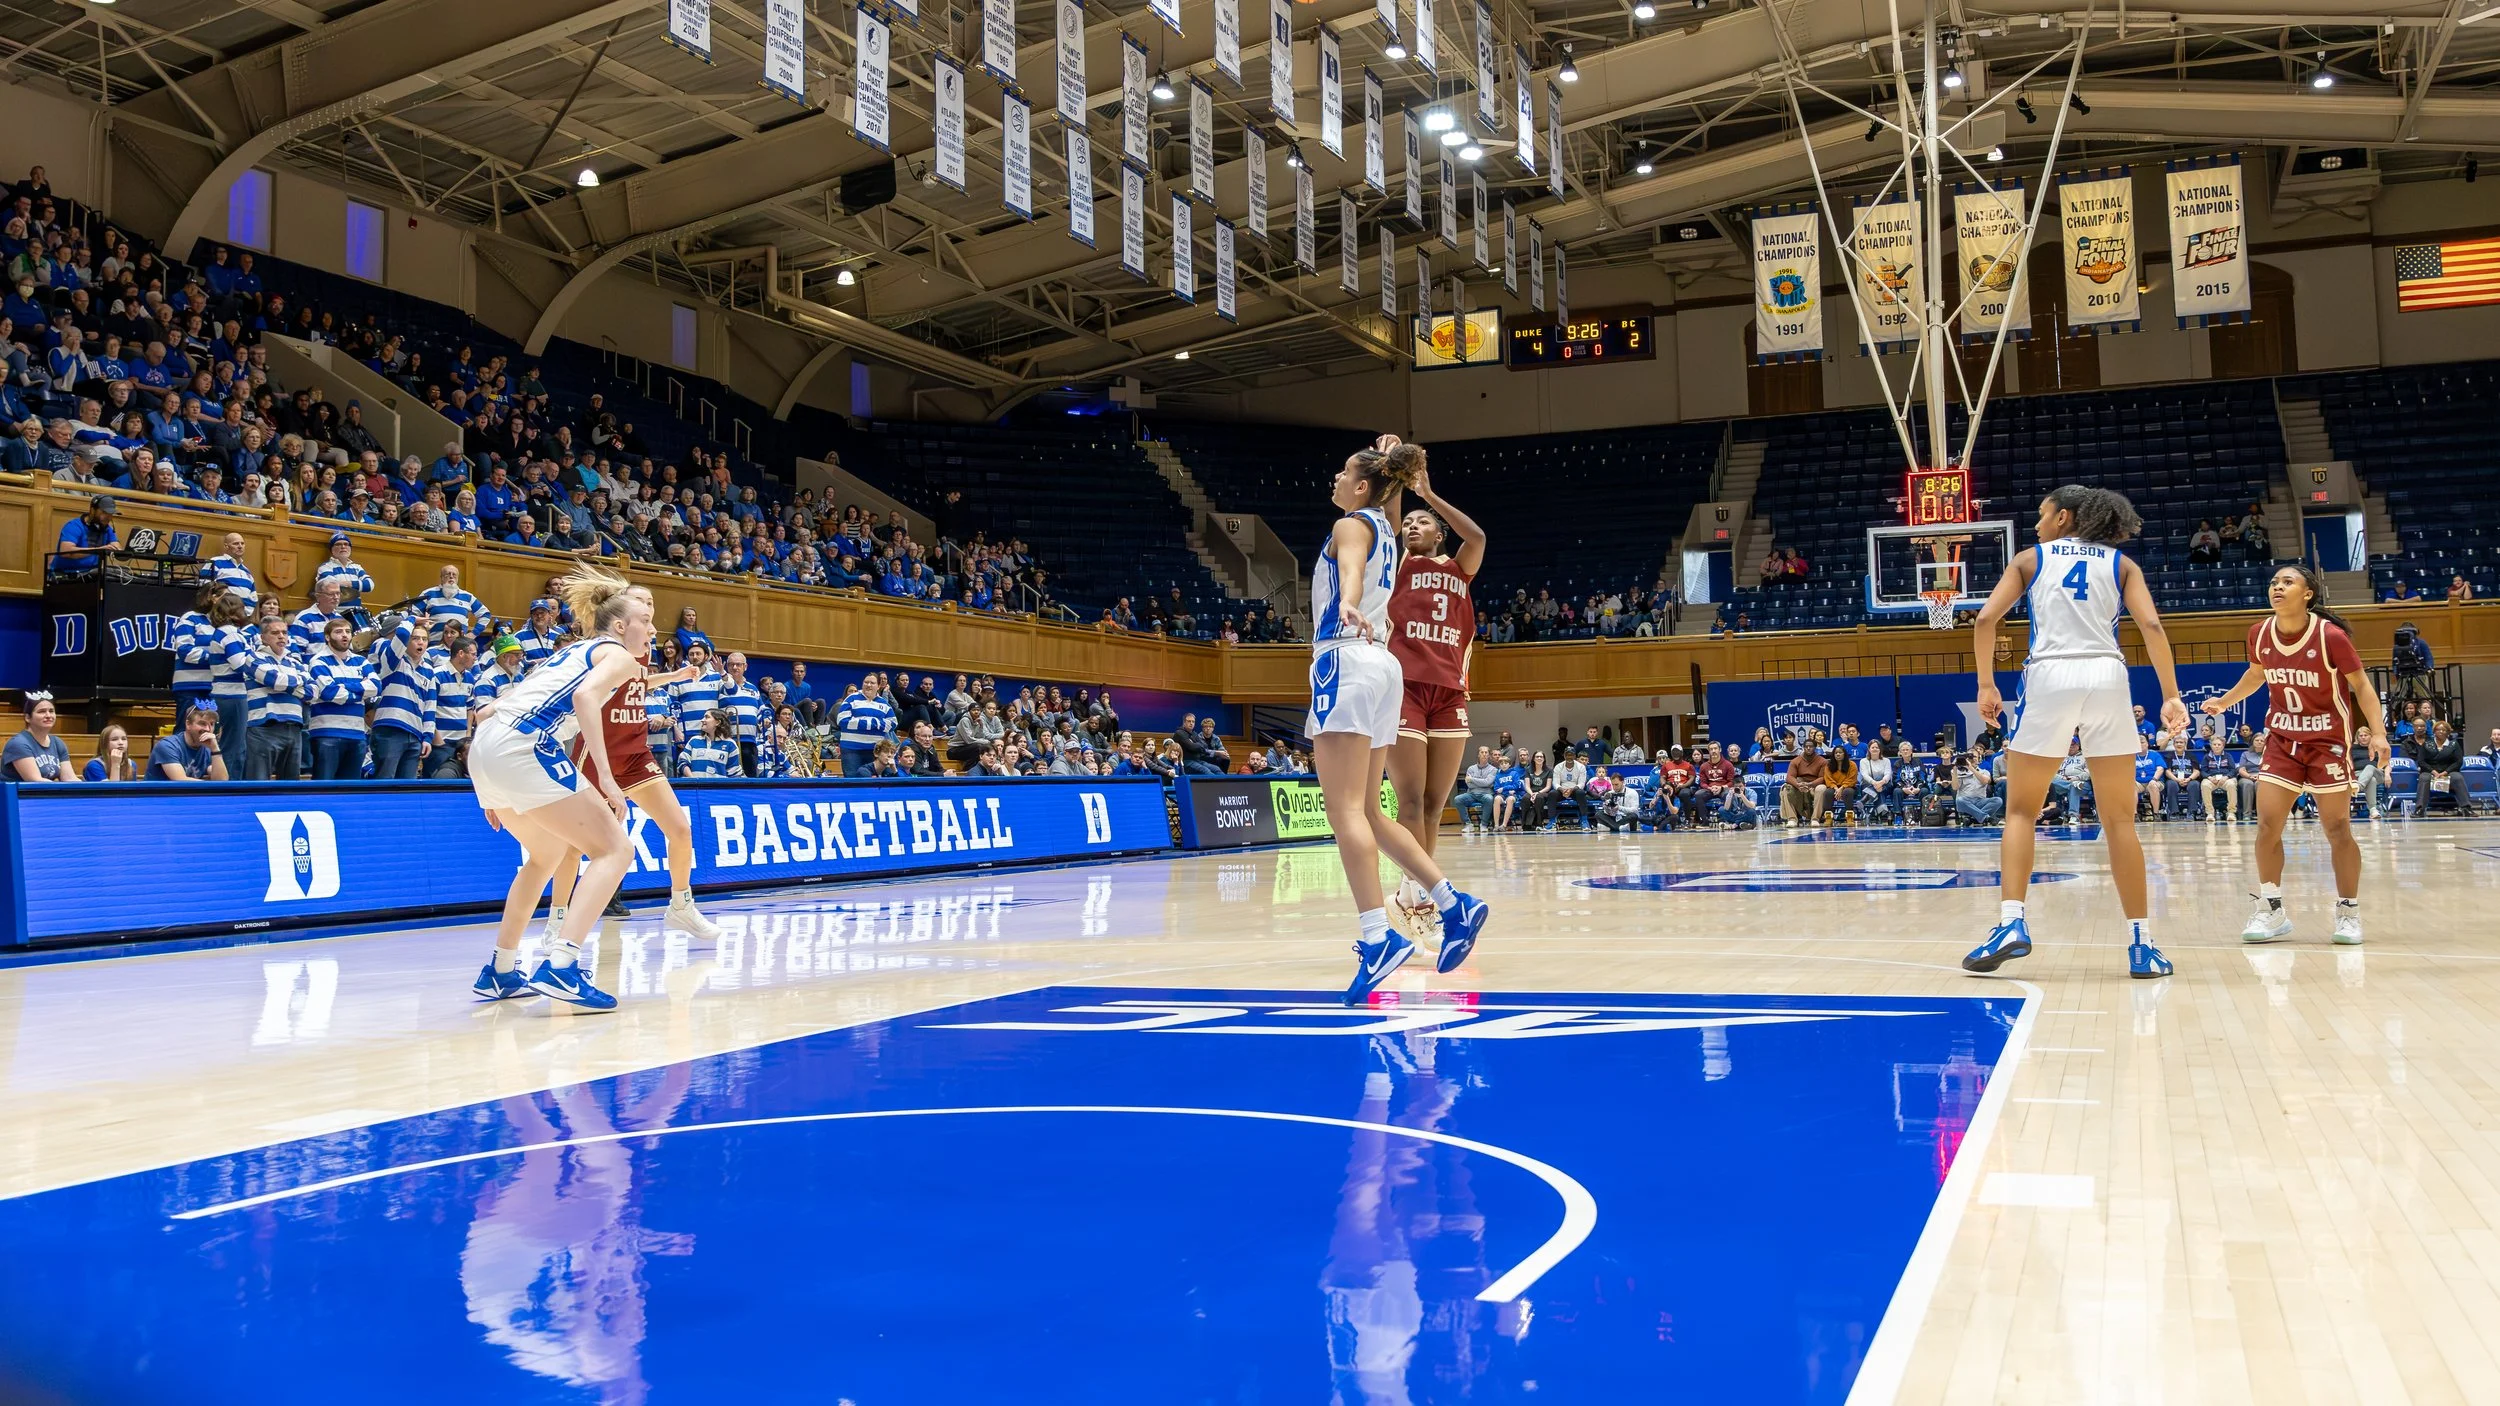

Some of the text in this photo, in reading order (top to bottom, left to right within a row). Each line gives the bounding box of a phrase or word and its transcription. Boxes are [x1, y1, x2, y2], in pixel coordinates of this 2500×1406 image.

[773, 3, 799, 24] ATLANTIC
[993, 3, 1008, 19] COAST
[683, 23, 699, 40] 2006
[778, 16, 795, 32] COAST
[986, 10, 1015, 36] CONFERENCE
[767, 24, 803, 50] CONFERENCE
[987, 23, 1014, 47] CHAMPIONS
[768, 38, 802, 62] CHAMPIONS
[1062, 42, 1080, 61] ATLANTIC
[862, 59, 885, 80] ATLANTIC
[1065, 55, 1078, 70] COAST
[779, 68, 793, 83] 2009
[866, 72, 881, 89] COAST
[1059, 62, 1085, 84] CONFERENCE
[858, 80, 888, 103] CONFERENCE
[1060, 74, 1084, 96] CHAMPIONS
[941, 107, 961, 124] ATLANTIC
[866, 120, 881, 134] 2010
[1010, 139, 1027, 155] ATLANTIC
[946, 164, 958, 177] 2011
[2179, 184, 2233, 202] NATIONAL
[2071, 196, 2122, 213] NATIONAL
[2173, 199, 2240, 218] CHAMPIONS
[1864, 219, 1912, 235] NATIONAL
[2066, 210, 2130, 229] CHAMPIONS
[1762, 231, 1810, 247] NATIONAL
[1960, 222, 2021, 239] CHAMPIONS
[2202, 228, 2239, 247] FINAL
[1858, 234, 1913, 251] CHAMPION
[2089, 238, 2124, 252] FINAL
[2188, 238, 2238, 264] FOUR
[1757, 244, 1816, 262] CHAMPIONS
[2076, 249, 2126, 268] FOUR
[2196, 282, 2230, 297] 2015
[2088, 292, 2120, 307] 2010
[1621, 319, 1636, 328] BC
[1877, 313, 1907, 326] 1992
[1515, 328, 1542, 338] DUKE
[1567, 323, 1600, 340] 9:26
[1776, 323, 1804, 336] 1991
[1533, 342, 1543, 355] 4
[1630, 332, 1639, 348] 2
[1564, 346, 1572, 358] 0
[1594, 344, 1602, 356] 0
[1925, 476, 1961, 493] 8:26
[2314, 471, 2326, 482] 10
[1229, 521, 1238, 531] 12
[2051, 544, 2105, 559] NELSON
[1378, 541, 1393, 590] 12
[1411, 571, 1467, 600] BOSTON
[2062, 560, 2089, 601] 4
[1432, 593, 1448, 622] 3
[51, 613, 87, 657] D
[1406, 620, 1462, 648] COLLEGE
[624, 681, 646, 706] 23
[2283, 687, 2304, 714] 0
[1316, 694, 1330, 712] D
[1774, 712, 1829, 729] SISTERHOOD
[2271, 711, 2333, 732] COLLEGE
[552, 760, 574, 780] D
[2465, 756, 2487, 767] DUKE
[1219, 796, 1249, 806] MARRIOTT
[1079, 792, 1112, 844] D
[1216, 809, 1256, 829] BONVOY
[709, 797, 1014, 868] BASKETBALL
[254, 811, 341, 902] D
